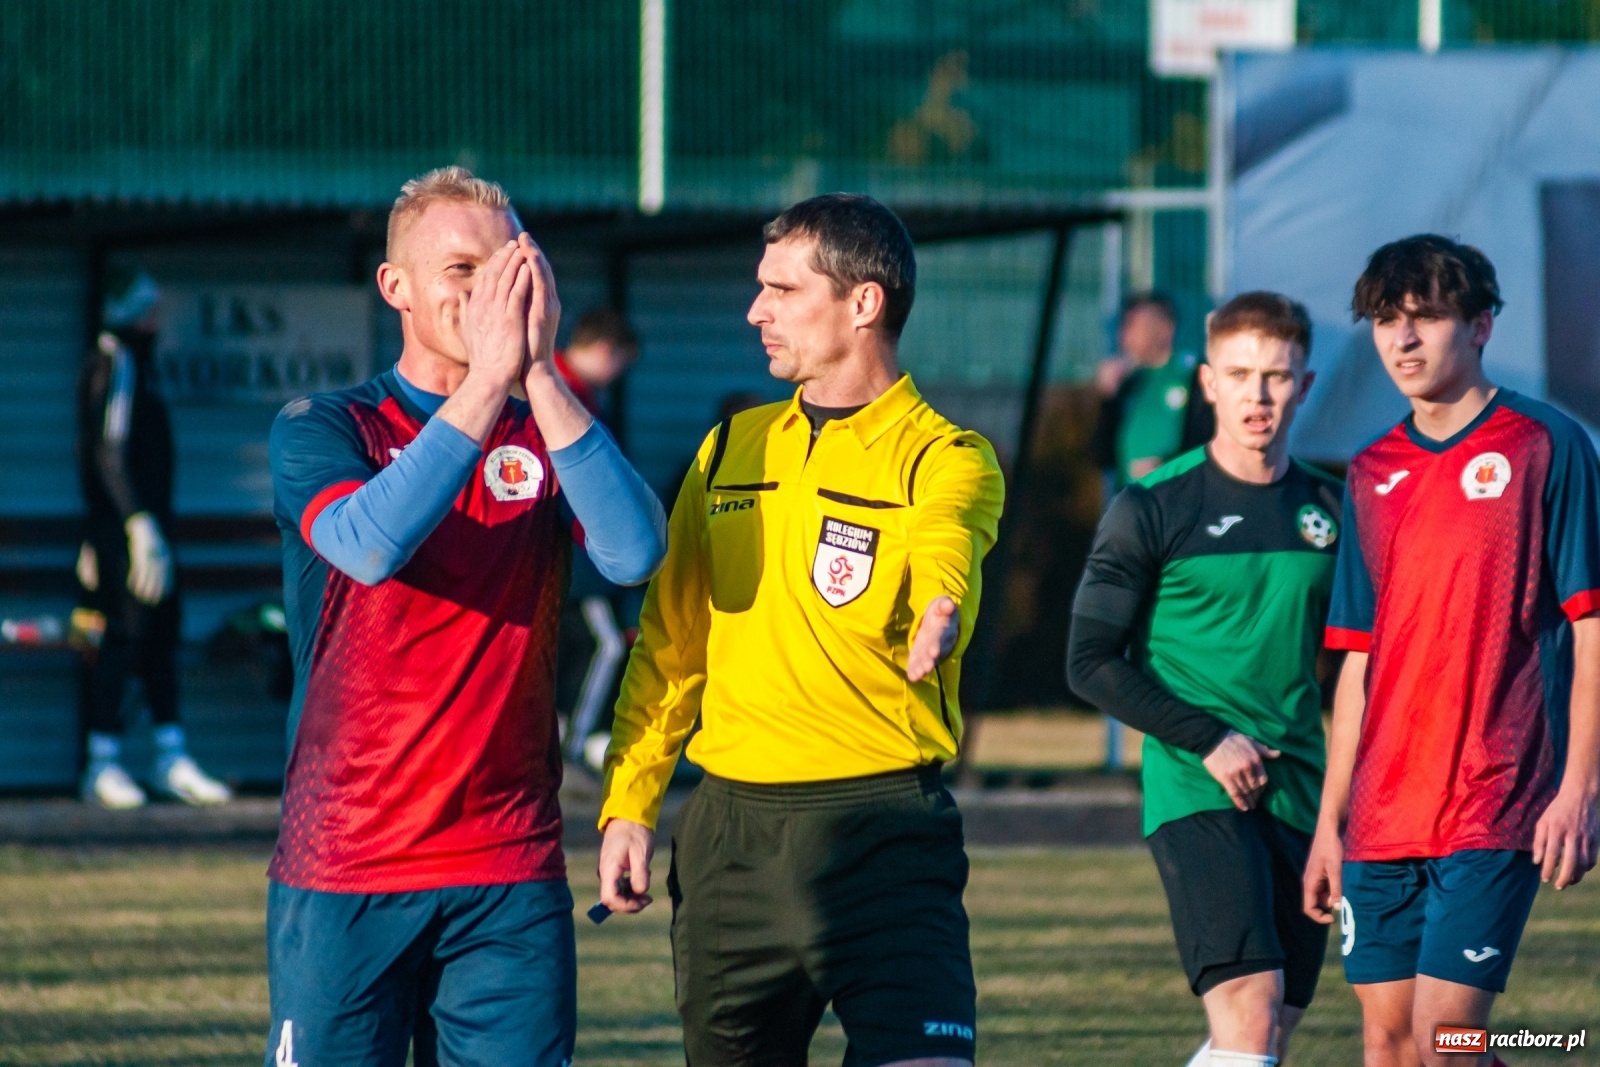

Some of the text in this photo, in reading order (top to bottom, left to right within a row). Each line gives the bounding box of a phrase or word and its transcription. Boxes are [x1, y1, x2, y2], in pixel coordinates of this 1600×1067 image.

[709, 497, 755, 516] zina
[826, 520, 873, 542] KOLEGIUM
[825, 532, 869, 553] SĘDZIÓW
[275, 1019, 298, 1067] 4
